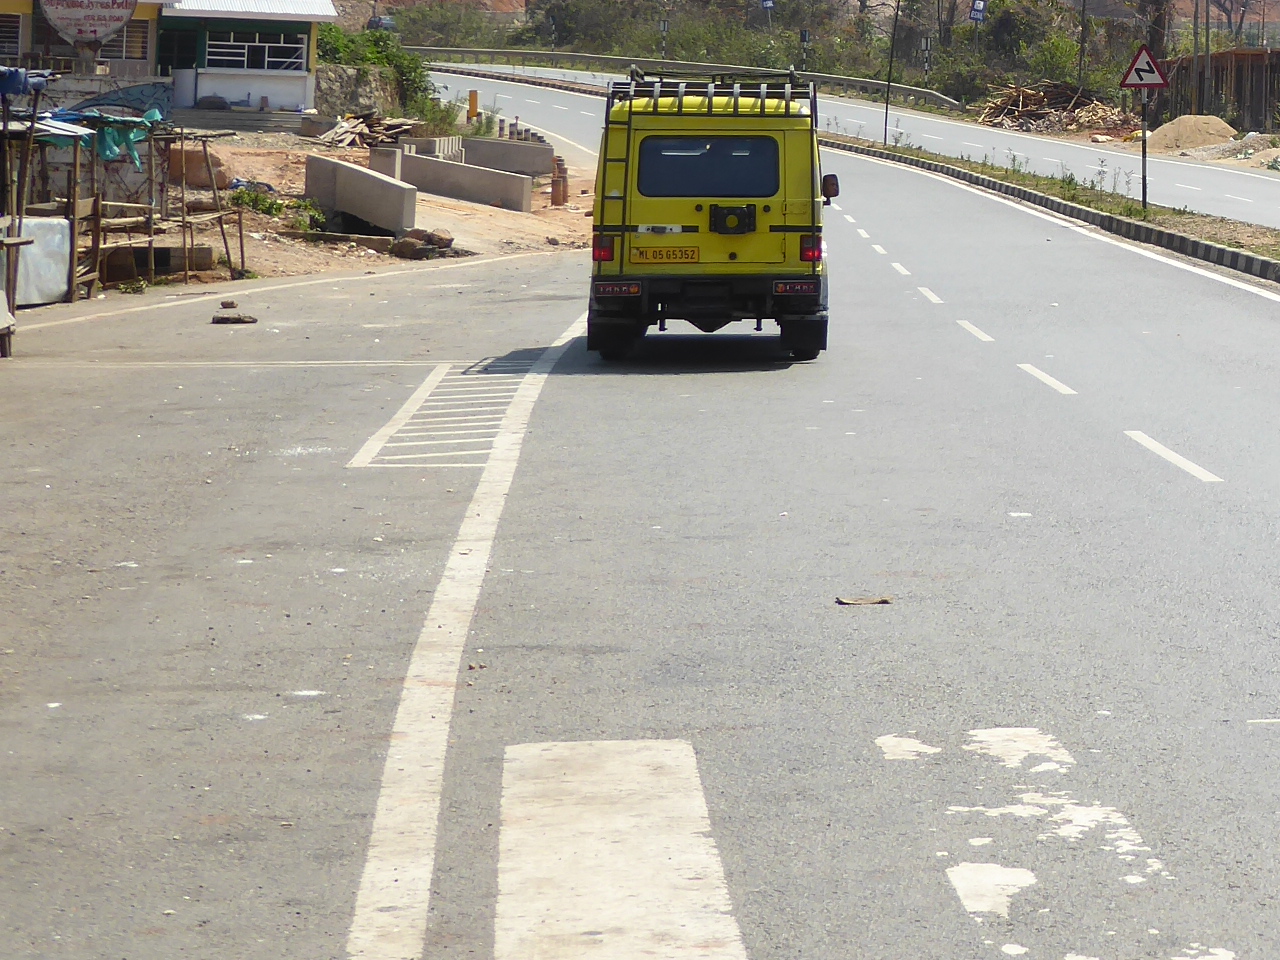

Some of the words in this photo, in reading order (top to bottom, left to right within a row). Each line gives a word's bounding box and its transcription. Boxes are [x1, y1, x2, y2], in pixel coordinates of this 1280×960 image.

[639, 250, 649, 260] ML
[652, 250, 663, 260] 05
[666, 249, 695, 260] G5352
